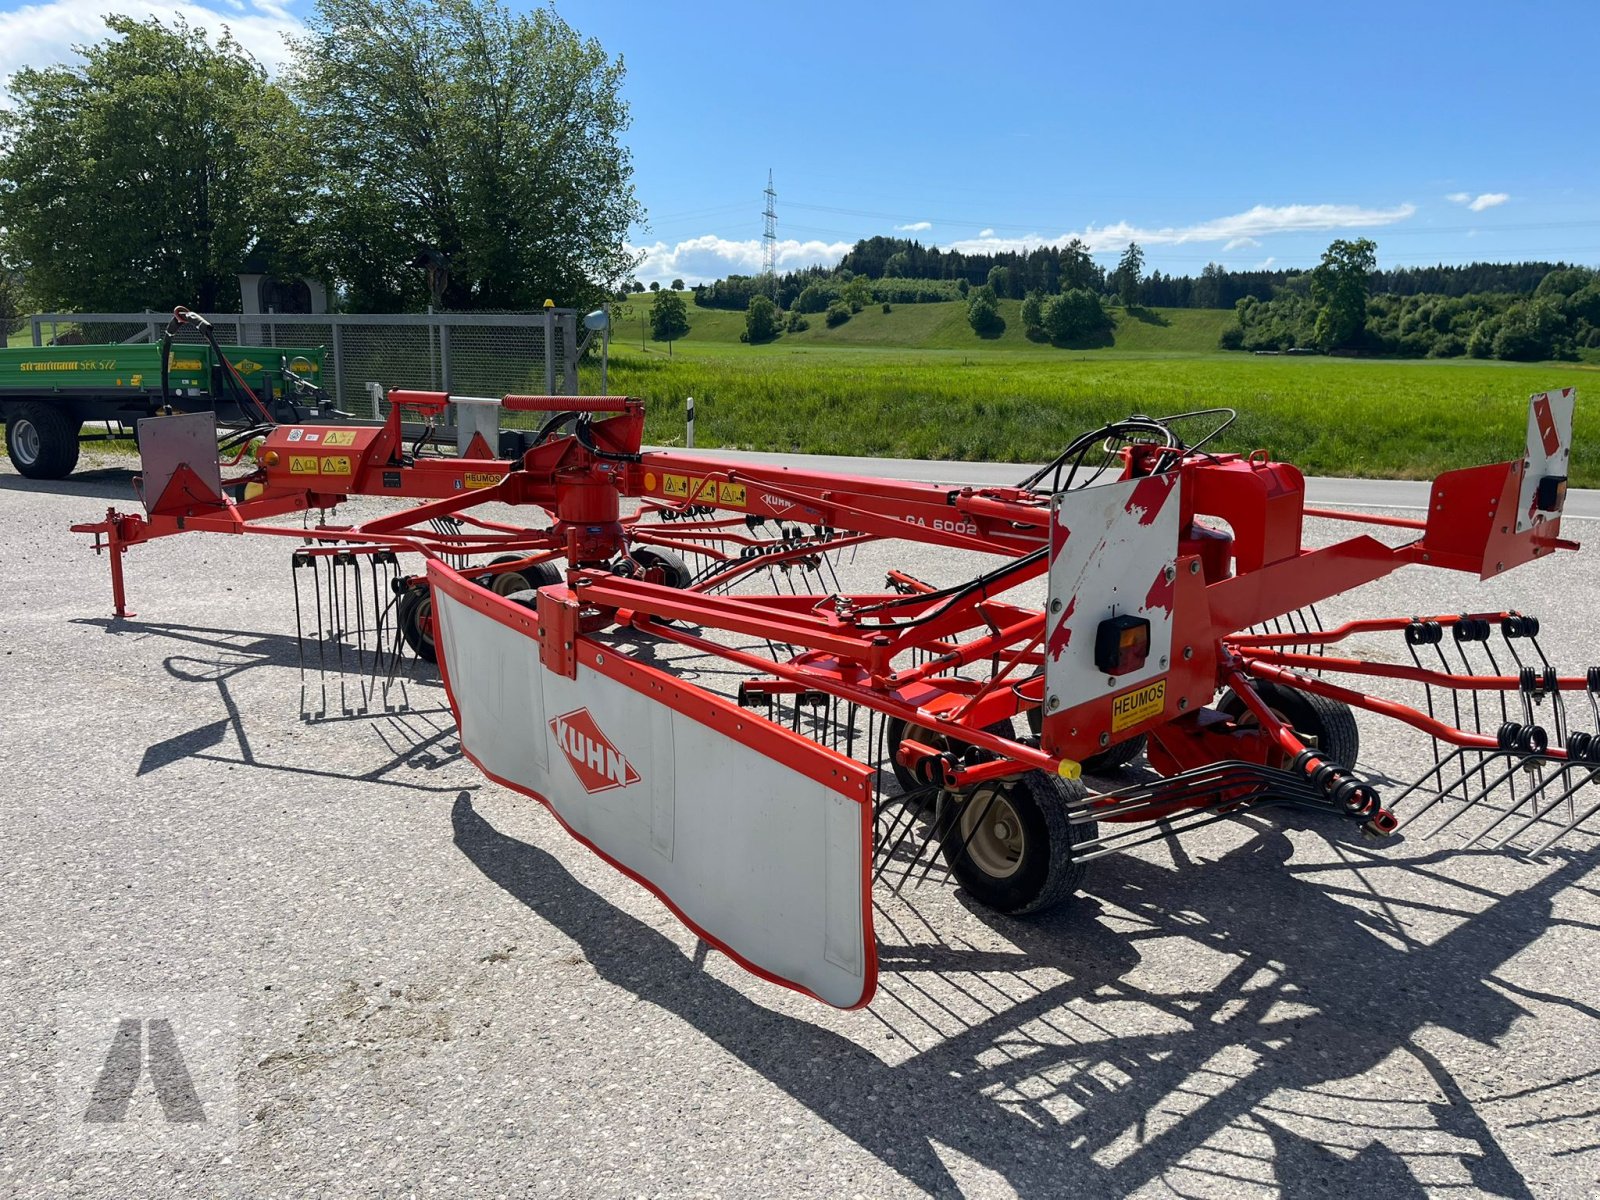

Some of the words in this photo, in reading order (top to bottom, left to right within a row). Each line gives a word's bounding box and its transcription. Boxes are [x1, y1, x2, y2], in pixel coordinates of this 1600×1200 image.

[466, 474, 500, 483] HEUMOS
[905, 515, 926, 527] GA
[933, 519, 977, 535] 6002
[1114, 684, 1163, 716] HEUMOS
[555, 715, 627, 787] KUHN
